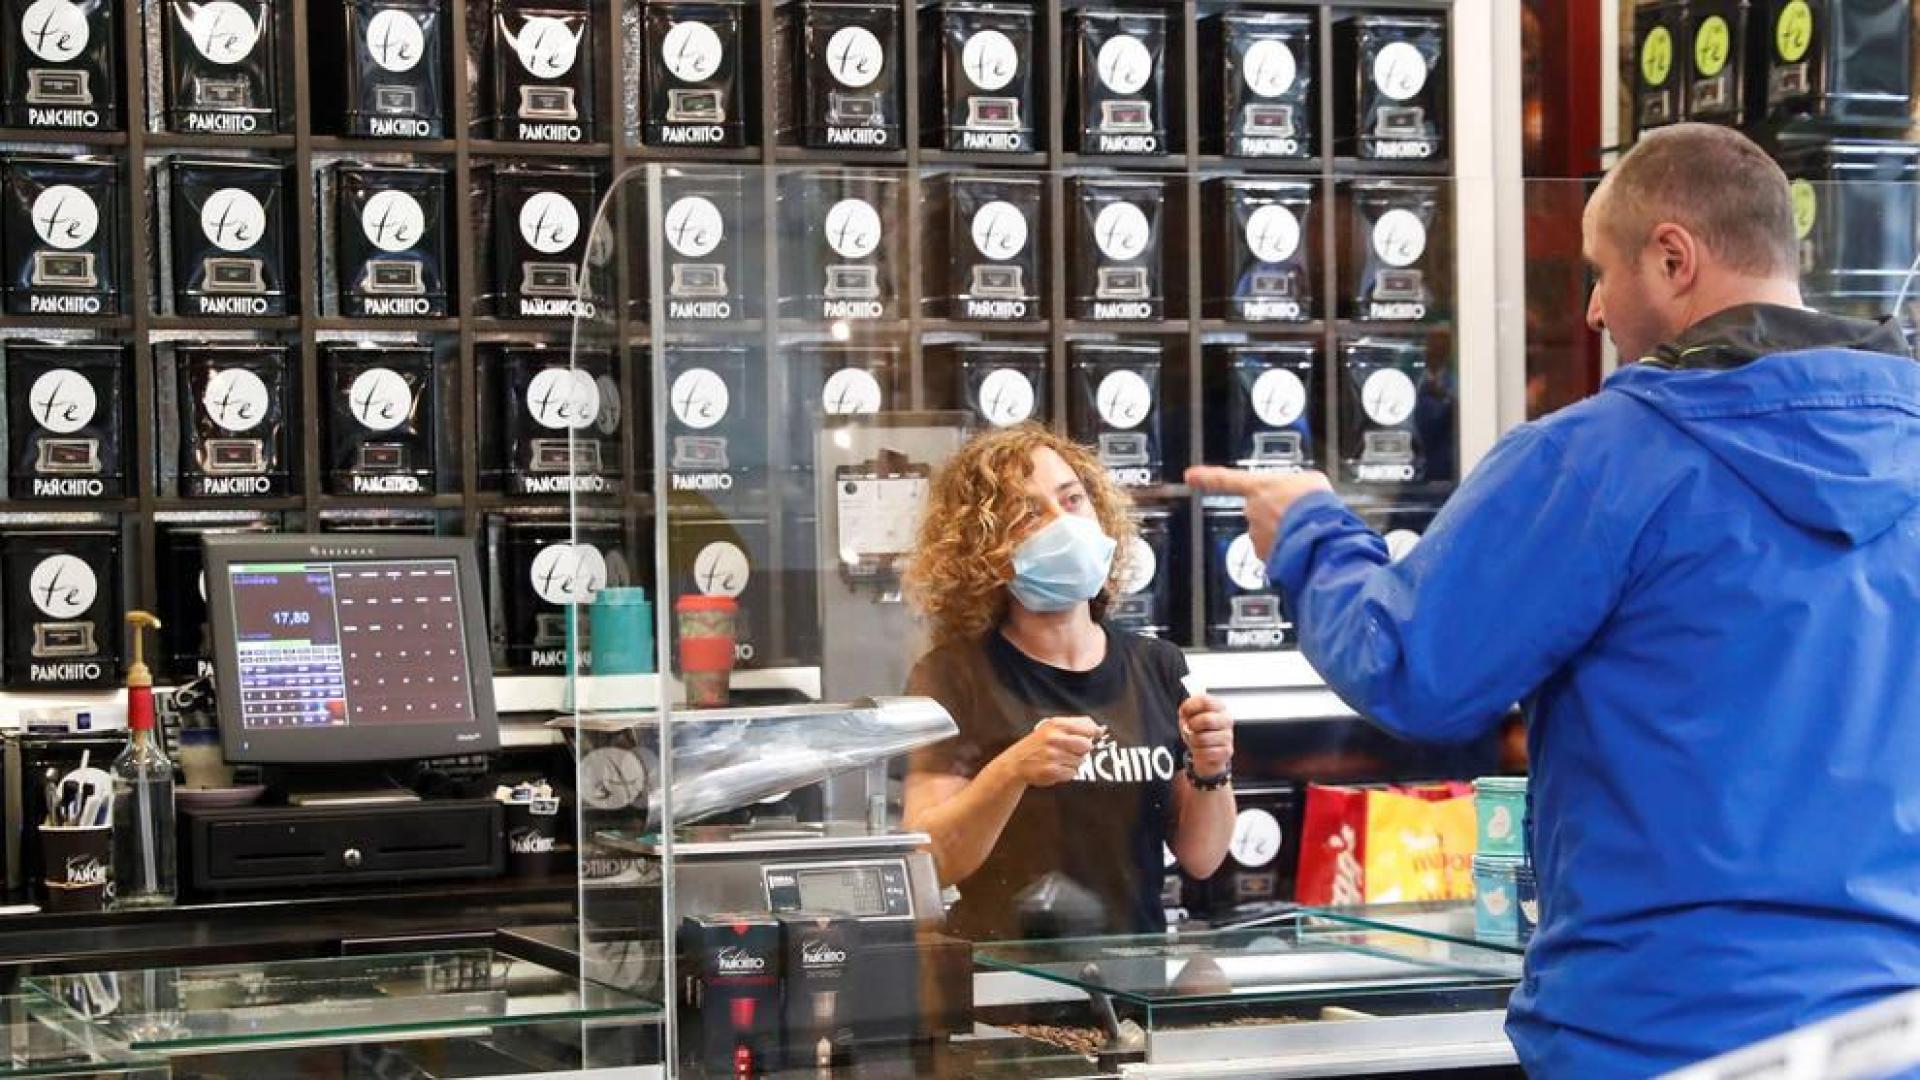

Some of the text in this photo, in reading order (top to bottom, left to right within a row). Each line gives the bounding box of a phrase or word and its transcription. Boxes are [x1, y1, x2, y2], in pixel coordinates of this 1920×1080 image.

[30, 6, 72, 52] te
[376, 19, 413, 62] te
[836, 36, 869, 75] te
[28, 108, 99, 127] PANCHITO
[189, 112, 256, 131] PANCHITO
[370, 118, 429, 137] PANCHITO
[519, 123, 581, 142] PANCHITO
[662, 125, 724, 143] PANCHITO
[827, 126, 887, 144] PANCHITO
[963, 131, 1020, 149] PANCHITO
[40, 197, 82, 240] te
[210, 200, 250, 242] te
[371, 203, 409, 243] te
[528, 202, 565, 244] te
[673, 206, 707, 246] te
[30, 295, 99, 313] PANCHITO
[200, 296, 267, 314] PANCHITO
[364, 297, 430, 314] PANCHITO
[670, 301, 730, 318] PANCHITO
[37, 380, 79, 423] te
[213, 381, 253, 421] te
[355, 380, 394, 421] te
[680, 379, 713, 418] te
[34, 478, 103, 496] PANCHITO
[204, 476, 270, 494] PANCHITO
[354, 476, 420, 493] PANCHITO
[673, 474, 732, 490] PANCHITO
[39, 564, 80, 607] te
[31, 663, 101, 681] PANCHITO
